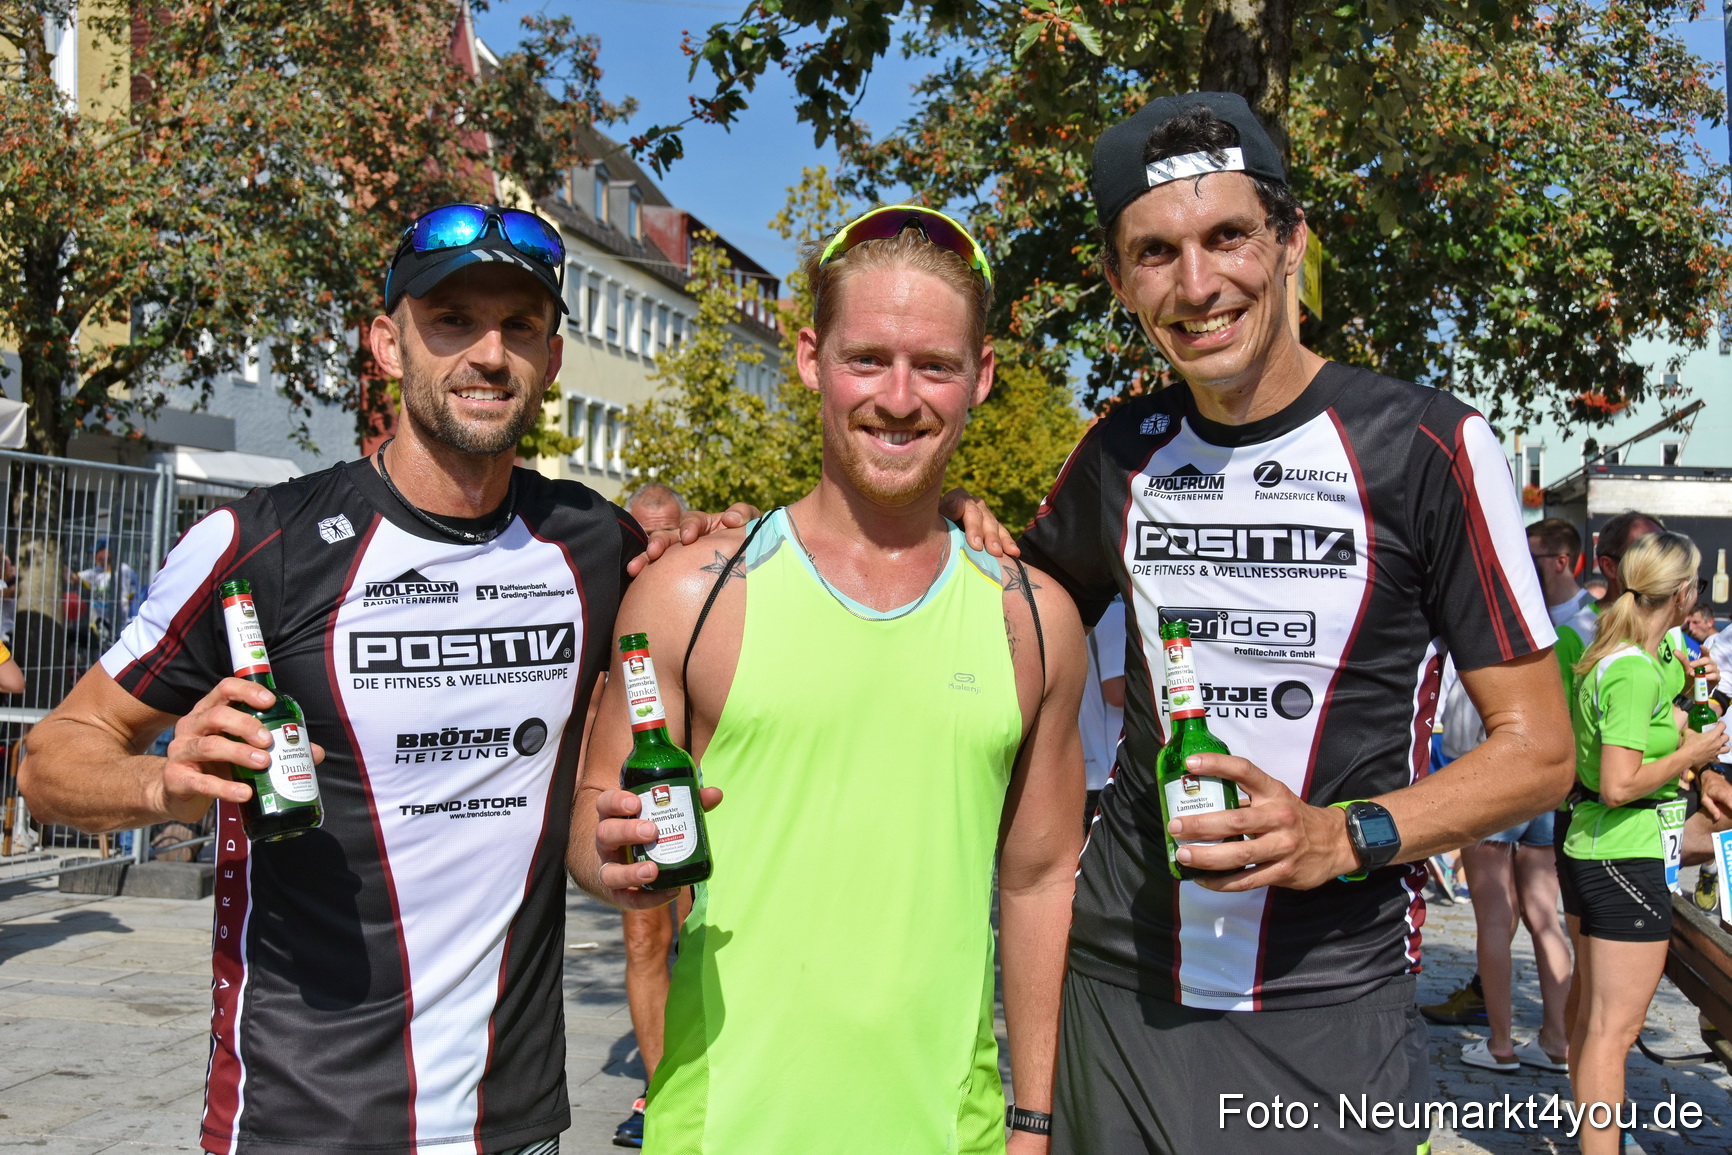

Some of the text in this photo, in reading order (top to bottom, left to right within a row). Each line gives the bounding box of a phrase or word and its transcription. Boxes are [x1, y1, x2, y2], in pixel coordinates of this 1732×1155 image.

[1284, 468, 1348, 483] ZURICH
[1148, 476, 1225, 491] WOLFRUM
[1143, 490, 1224, 501] BAUUNTERNEHMEN
[1132, 564, 1348, 579] DIE FITNESS & WELLNESSGRUPPE
[365, 581, 459, 598] WOLFRUM
[500, 582, 548, 591] Raiffeisenbank
[363, 596, 459, 608] BAUUNTERNEHMEN
[1234, 647, 1316, 659] Profiltechnik GmbH
[353, 668, 568, 690] DIE FITNESS & WELLNESSGRUPPE
[628, 686, 656, 699] Dunkel
[1162, 683, 1268, 703] ÖTJE
[396, 727, 511, 749] BRÖTJE
[395, 747, 509, 764] HEIZUNG
[449, 810, 511, 819] www.trendstore.de
[1176, 802, 1214, 812] Lammsbräu
[658, 821, 688, 836] unkel
